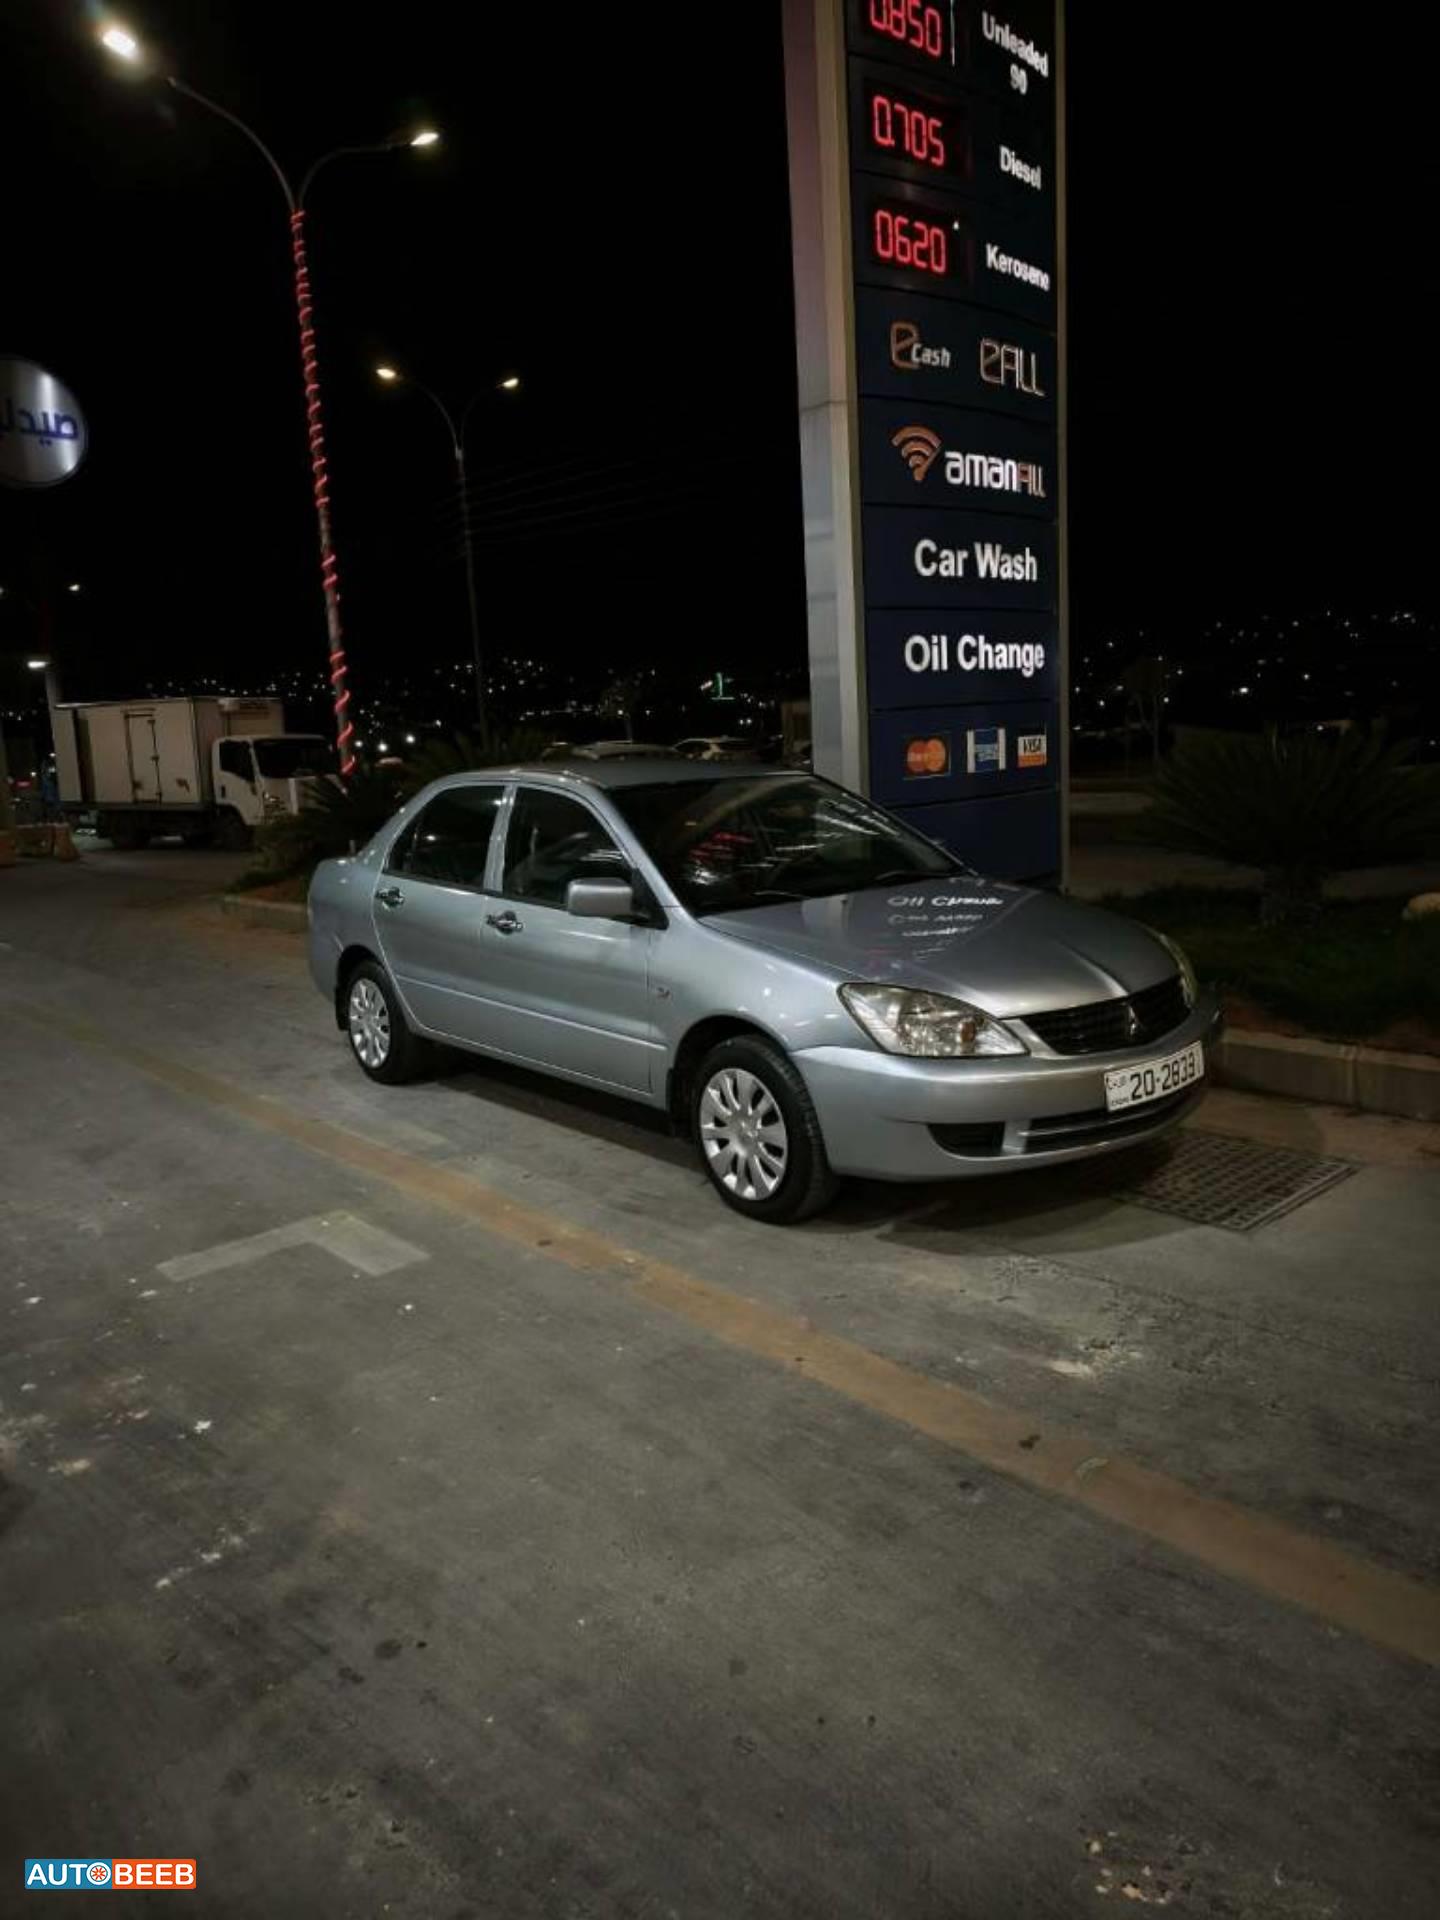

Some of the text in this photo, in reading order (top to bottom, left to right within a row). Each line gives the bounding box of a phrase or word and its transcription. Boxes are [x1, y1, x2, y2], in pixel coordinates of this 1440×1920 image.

[982, 11, 1049, 77] Unleaded
[1000, 145, 1042, 190] Diesel
[985, 243, 1050, 292] Kerosene
[914, 538, 1038, 582] Car Wash
[904, 634, 1045, 678] Oil Change
